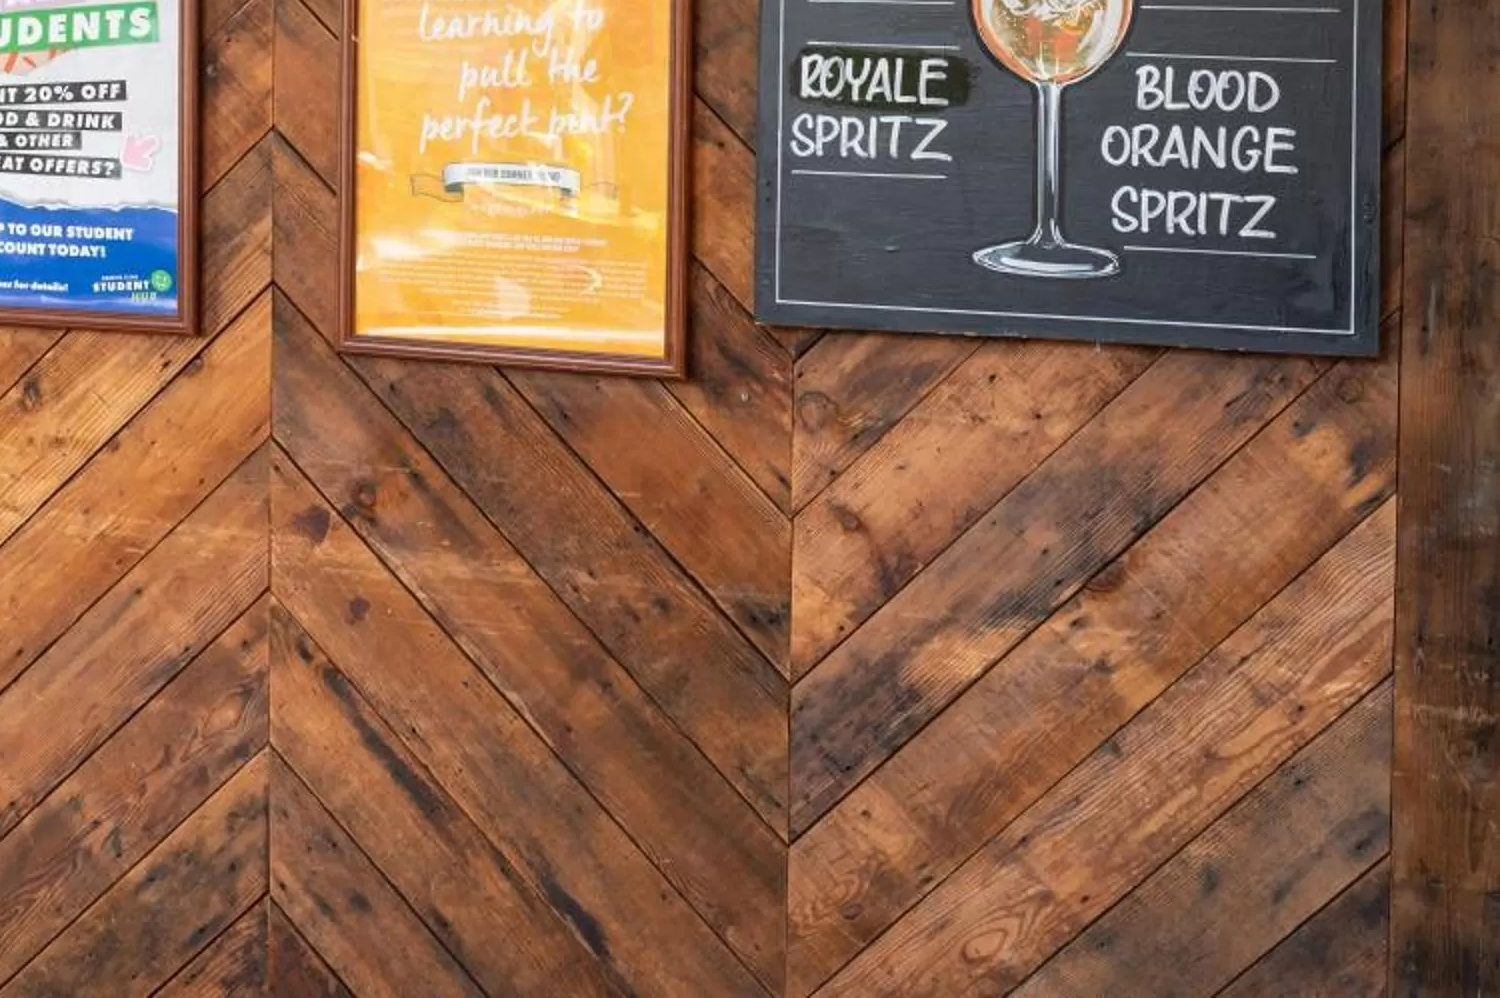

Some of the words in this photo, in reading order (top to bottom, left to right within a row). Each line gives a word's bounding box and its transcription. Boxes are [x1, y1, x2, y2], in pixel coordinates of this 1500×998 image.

[420, 0, 553, 58] learning
[24, 85, 75, 103] 20%
[81, 83, 121, 100] OFF
[459, 48, 531, 103] pull
[548, 47, 601, 84] the
[801, 53, 949, 106] ROYALE
[1135, 65, 1280, 113] BLOOD
[15, 133, 74, 148] OTHER
[25, 112, 40, 127] &
[47, 113, 116, 129] DRINK
[419, 97, 540, 155] perfect
[790, 113, 953, 162] SPRITZ
[29, 157, 115, 176] OFFERS?
[1101, 124, 1299, 174] ORANGE
[7, 223, 27, 236] TO
[30, 224, 62, 238] OUR
[66, 225, 133, 241] STUDENT
[1111, 185, 1277, 238] SPRITZ
[49, 243, 107, 259] TODAY!
[92, 279, 149, 294] STUDENT
